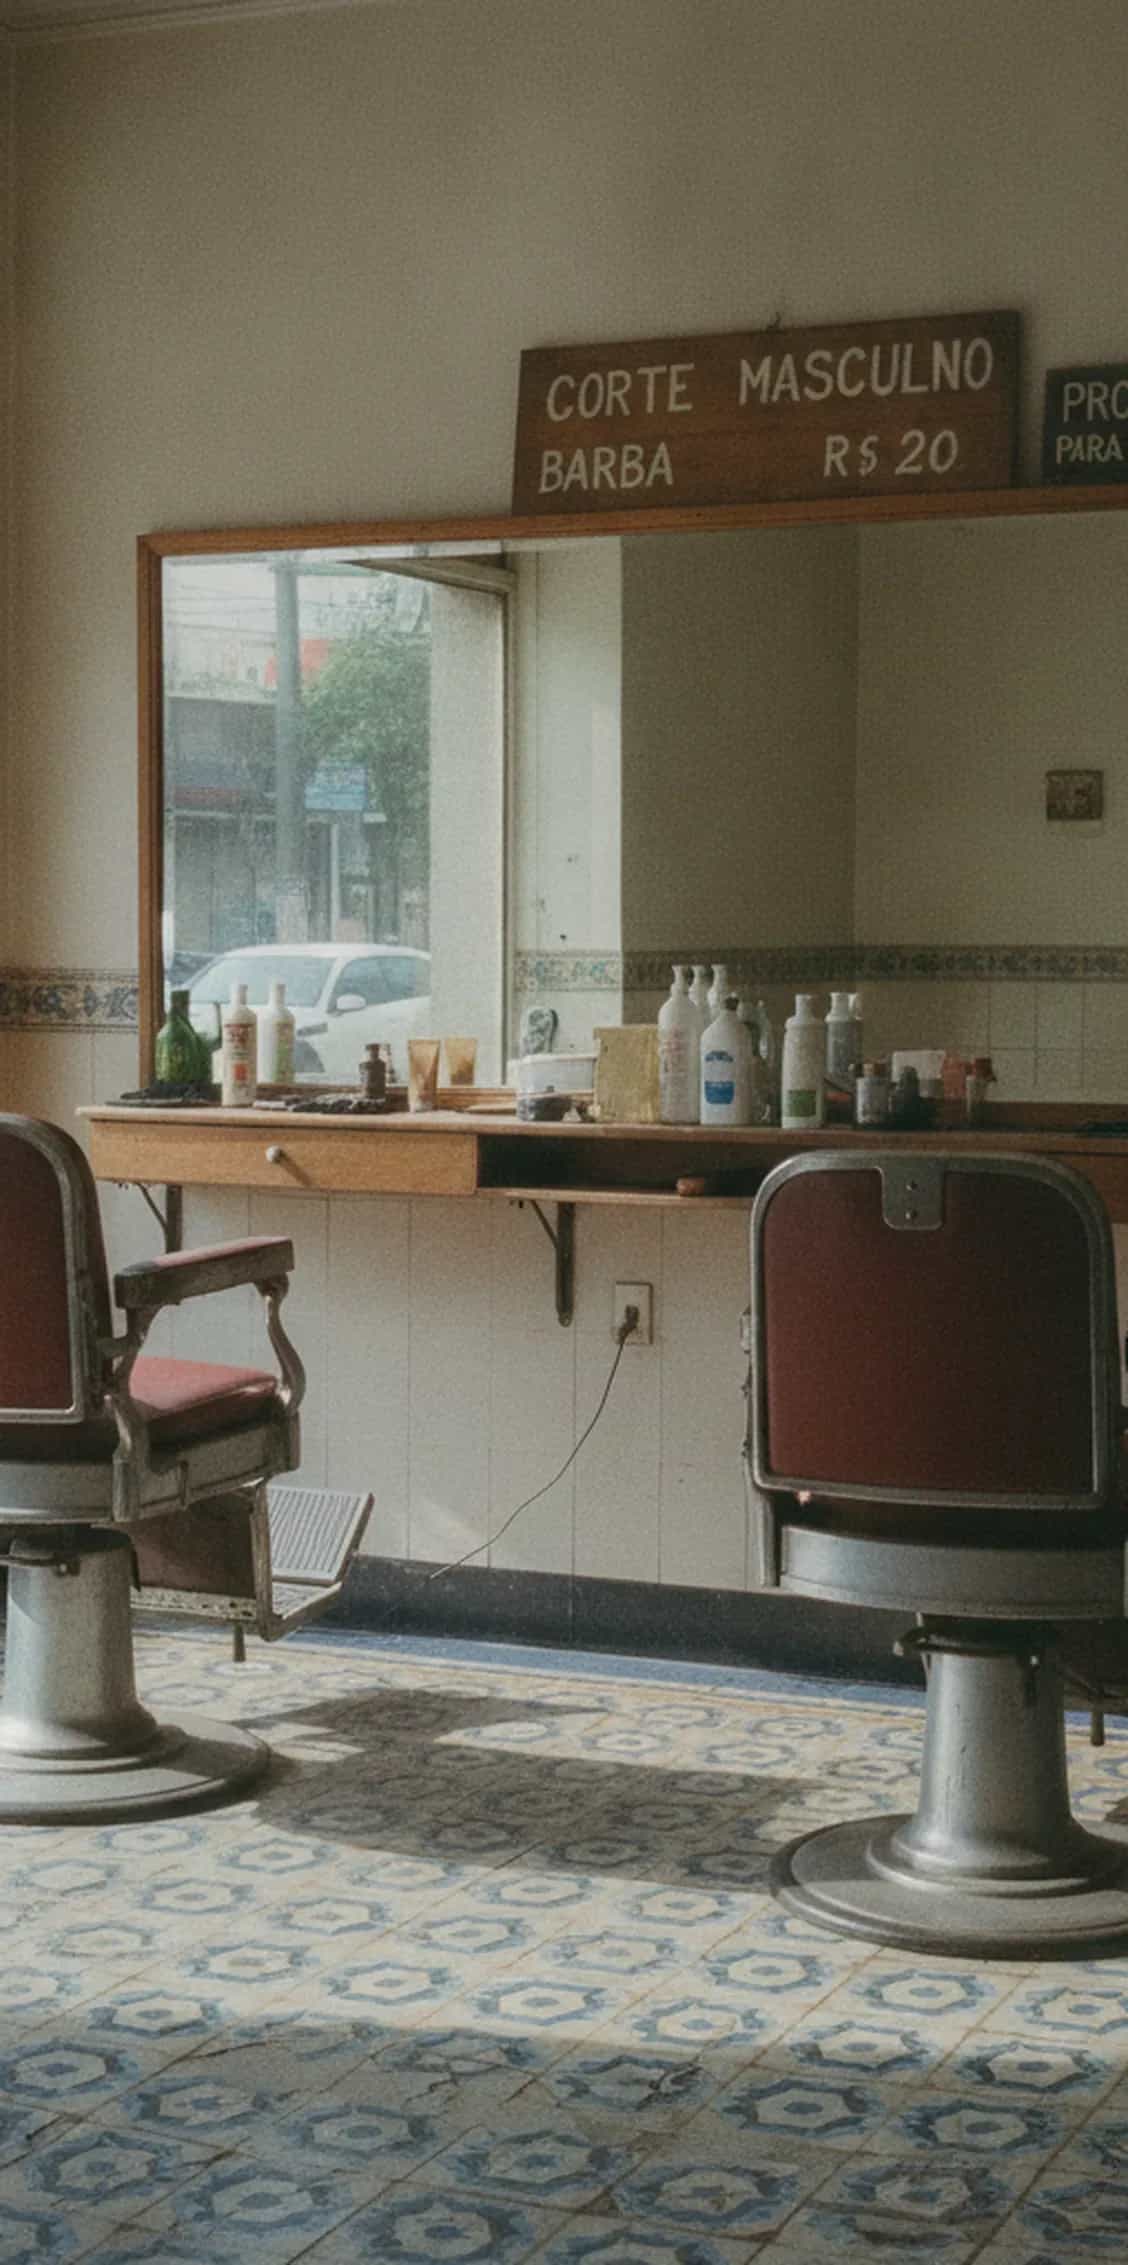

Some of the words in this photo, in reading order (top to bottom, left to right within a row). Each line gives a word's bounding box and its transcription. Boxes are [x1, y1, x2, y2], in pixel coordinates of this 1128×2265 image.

[546, 363, 695, 422] CORTE
[739, 337, 993, 406] MASCULNO
[538, 441, 673, 494] BARBA
[895, 429, 958, 475] 20
[1056, 433, 1124, 464] PARA
